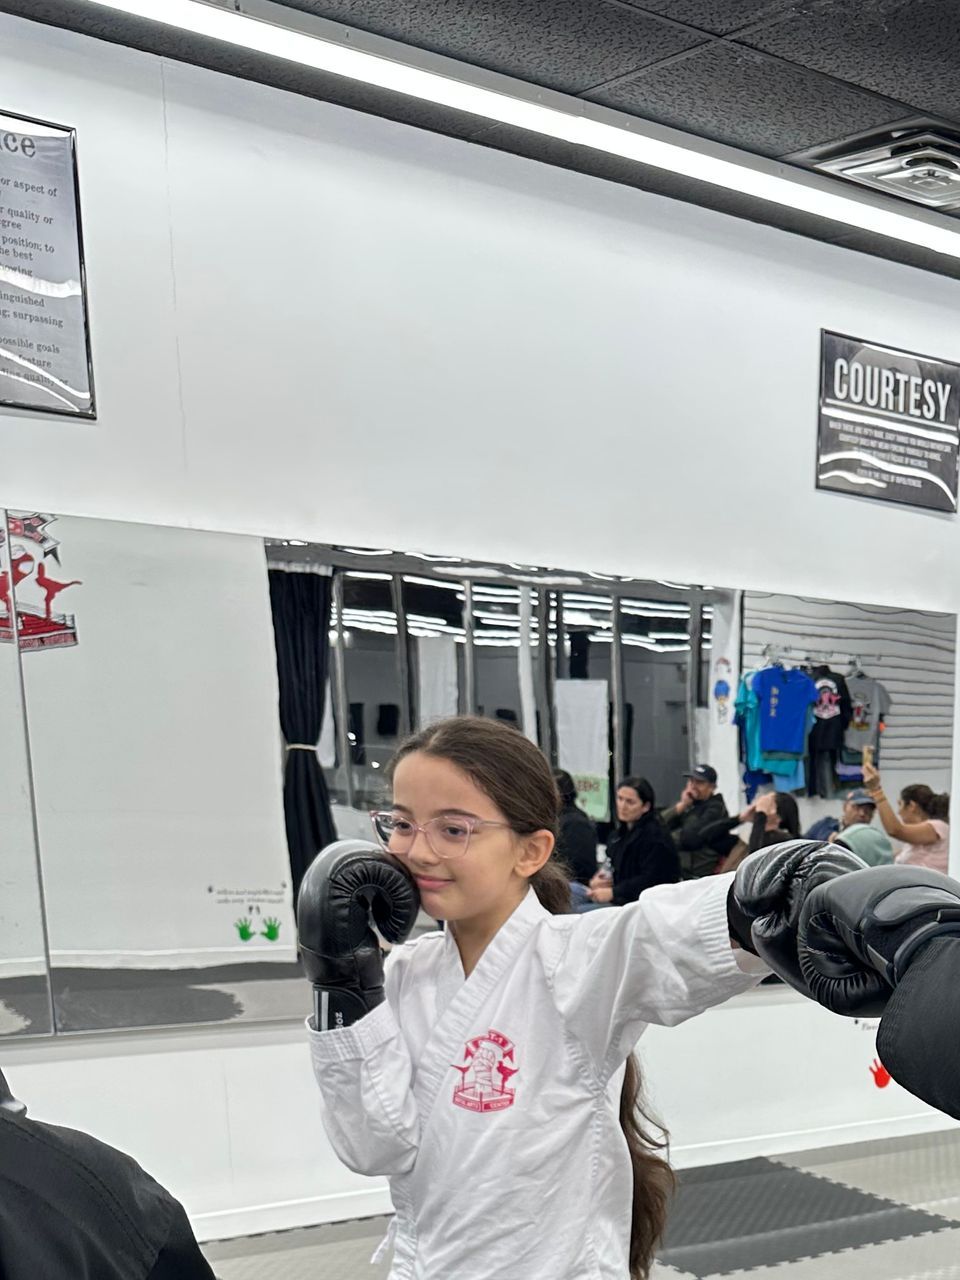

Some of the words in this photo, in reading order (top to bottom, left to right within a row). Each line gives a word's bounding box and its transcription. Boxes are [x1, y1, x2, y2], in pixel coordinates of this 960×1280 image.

[0, 133, 36, 158] ce
[14, 180, 45, 195] aspect
[48, 187, 58, 197] of
[7, 207, 41, 224] quality
[43, 216, 54, 225] or
[13, 248, 34, 261] best
[45, 243, 55, 254] to
[13, 310, 64, 328] surpassing
[37, 343, 60, 354] goals
[834, 357, 952, 422] COURTESY
